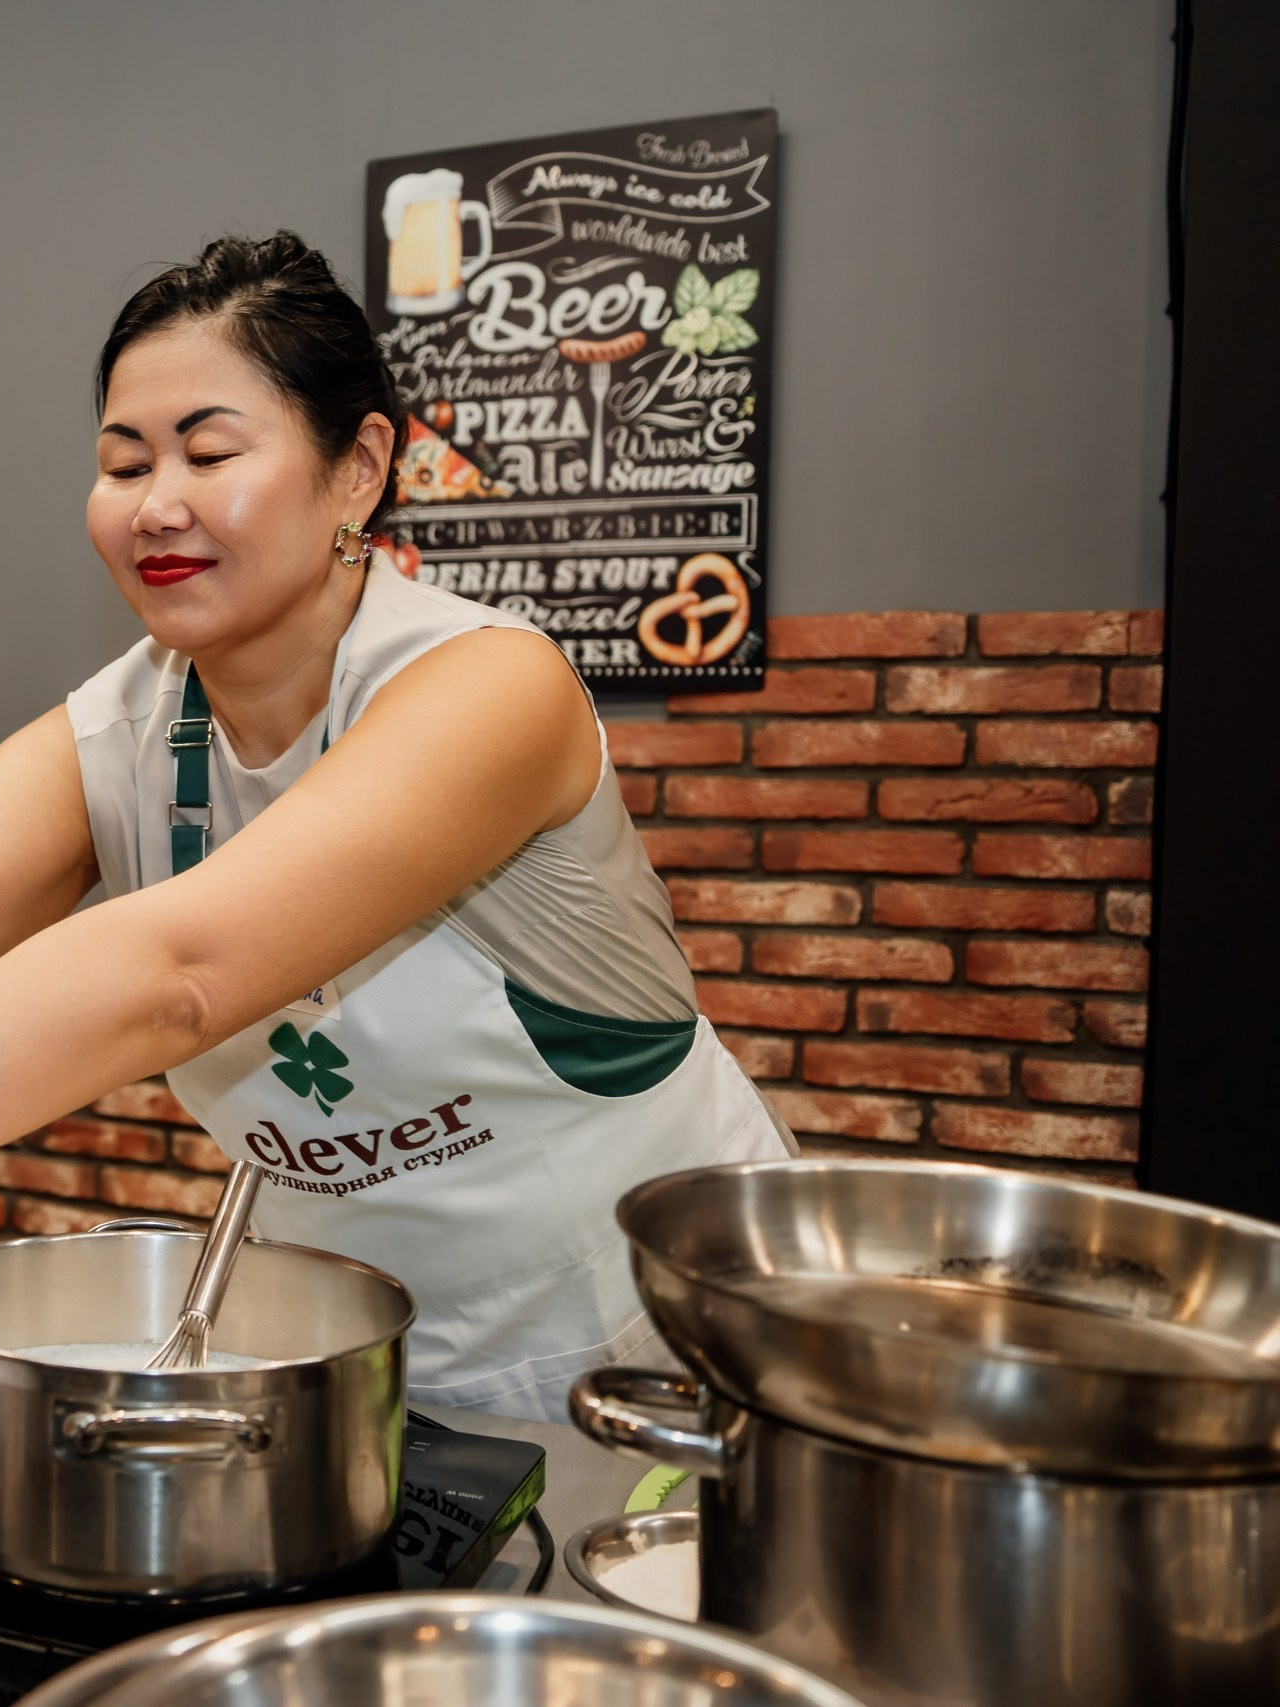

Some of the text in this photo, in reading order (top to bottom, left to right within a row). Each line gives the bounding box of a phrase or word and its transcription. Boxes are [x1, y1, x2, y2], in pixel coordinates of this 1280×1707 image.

[521, 165, 733, 211] Always ice cold
[571, 213, 750, 265] worldwide best
[467, 261, 673, 353] Beer
[388, 347, 586, 403] Dortmunder
[606, 349, 753, 423] Porter
[452, 395, 590, 446] PIZZA
[605, 397, 757, 462] Wurst &
[496, 443, 590, 496] Ale
[605, 458, 757, 495] Sausage
[417, 556, 679, 595] PERIAL STOUT
[244, 1093, 473, 1177] clever
[262, 1127, 496, 1198] кулинарная студия
